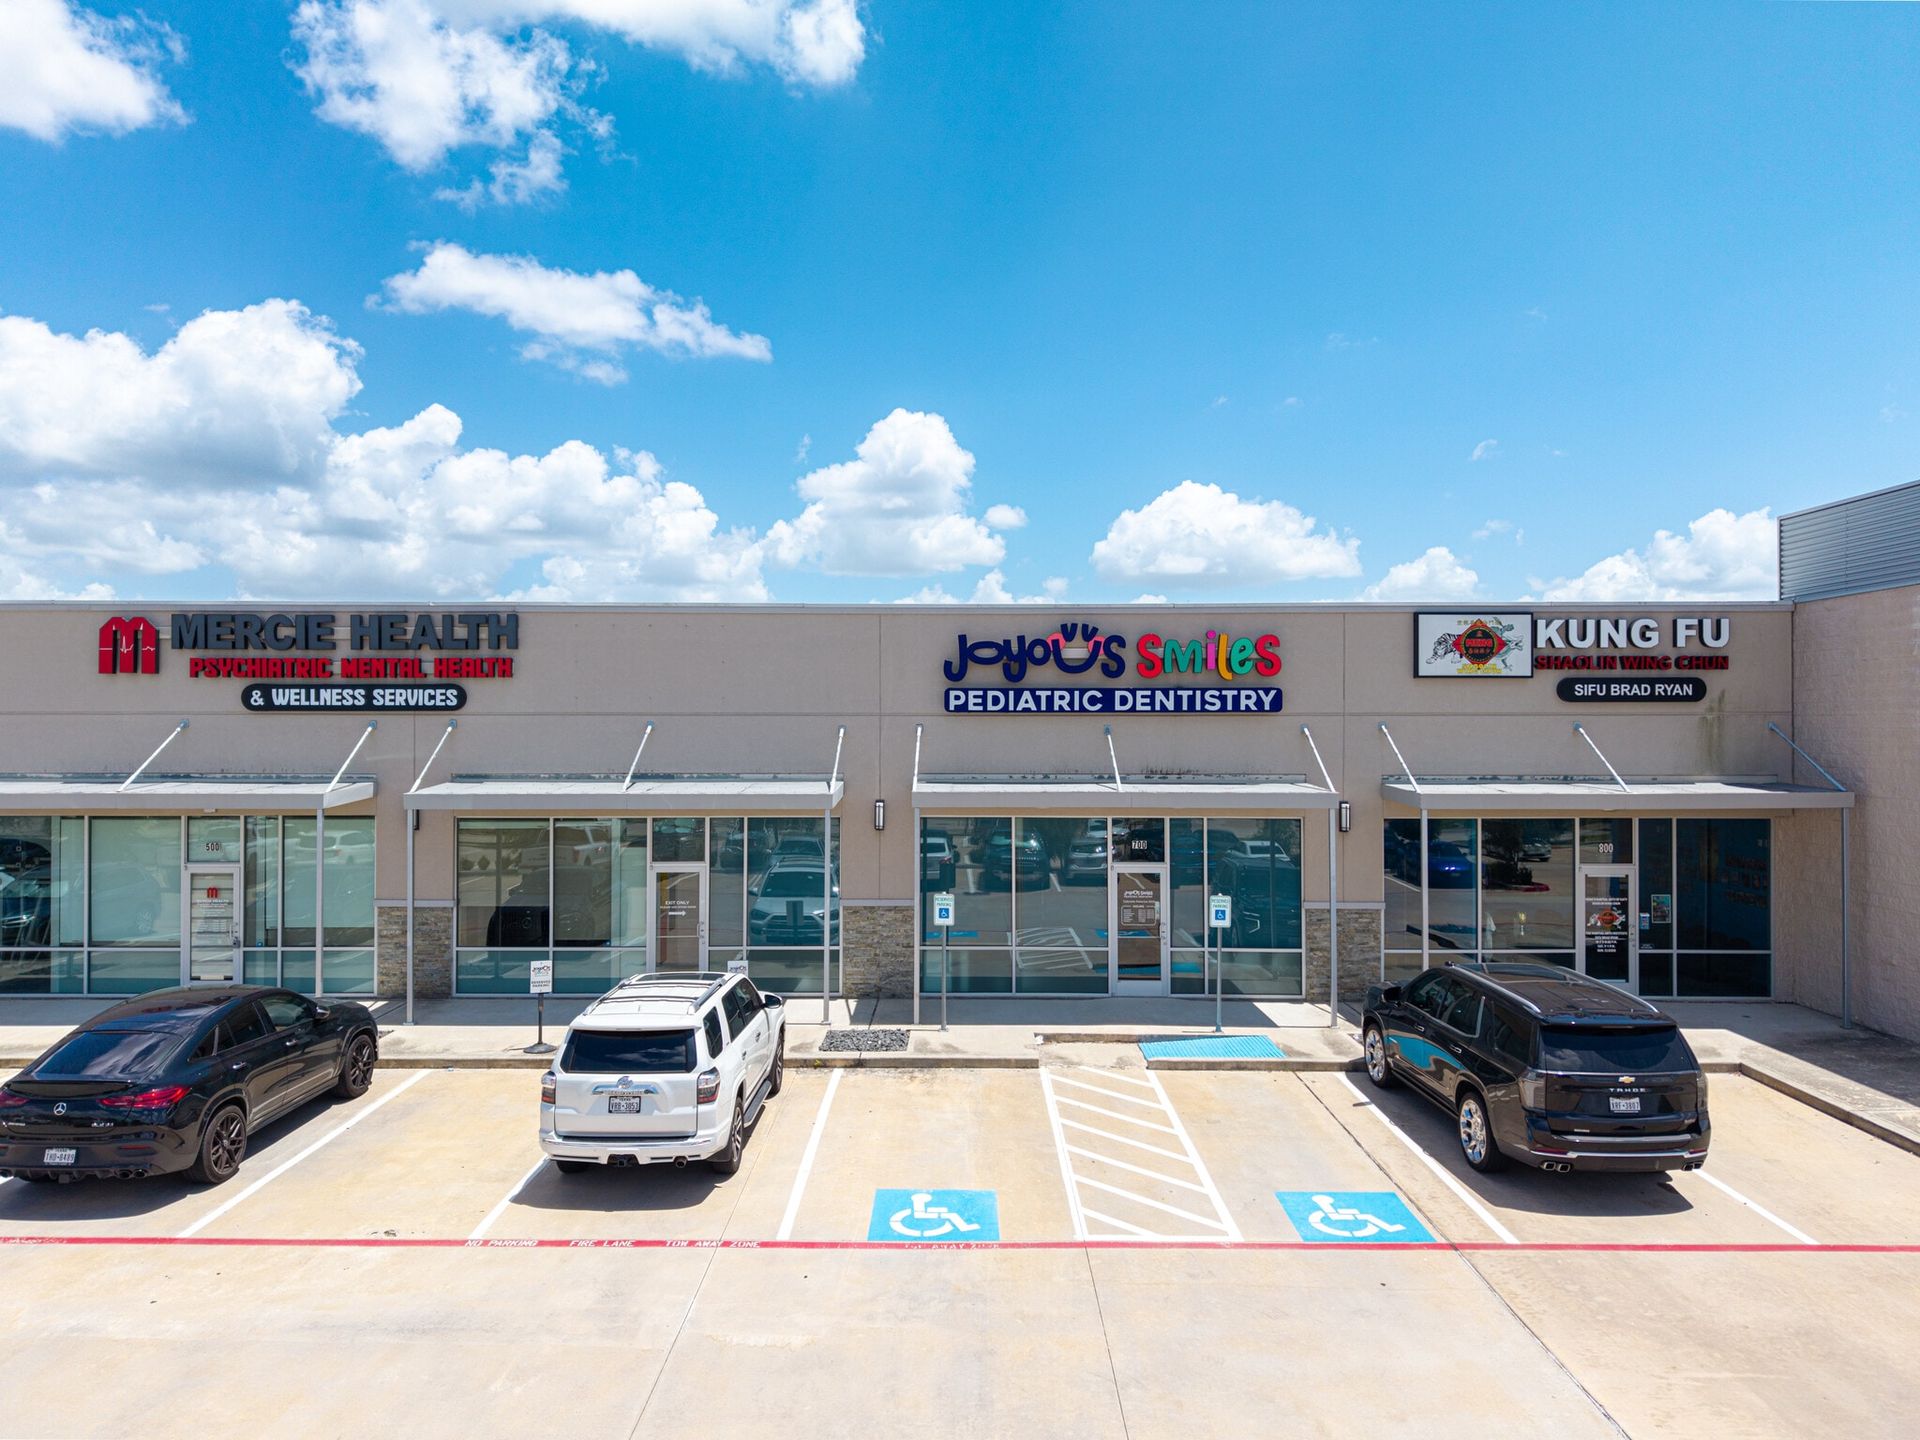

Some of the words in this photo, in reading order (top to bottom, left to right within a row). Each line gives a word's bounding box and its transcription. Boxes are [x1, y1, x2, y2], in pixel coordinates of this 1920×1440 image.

[171, 614, 337, 650] MERCIE
[350, 614, 519, 650] HEALTH
[1535, 618, 1660, 649] KUNG
[1673, 618, 1730, 649] FU
[189, 657, 332, 679] PSYCHIATRIC
[340, 657, 427, 679] MENTAL
[433, 657, 514, 679] HEALTH
[1535, 655, 1621, 671] SHAOLIN
[1623, 655, 1673, 671] WING
[1677, 655, 1729, 671] CHUN
[249, 689, 265, 706] &
[271, 688, 366, 706] WELLNESS
[372, 688, 458, 706] SERVICES
[1574, 683, 1607, 697] SIFU
[1610, 683, 1651, 697] BRAD
[1654, 683, 1694, 697] RYAN
[949, 689, 1104, 712] PEDIATRIC
[1114, 689, 1278, 712] DENTISTRY
[206, 843, 220, 852] 500
[1132, 840, 1148, 850] 700
[1598, 842, 1614, 853] 800
[465, 1239, 484, 1247] NO
[488, 1239, 538, 1248] PARKING
[569, 1239, 596, 1247] FIRE
[603, 1239, 636, 1248] LANE
[665, 1240, 689, 1248] TOW
[693, 1240, 722, 1248] AWAY
[730, 1240, 761, 1248] ZONE
